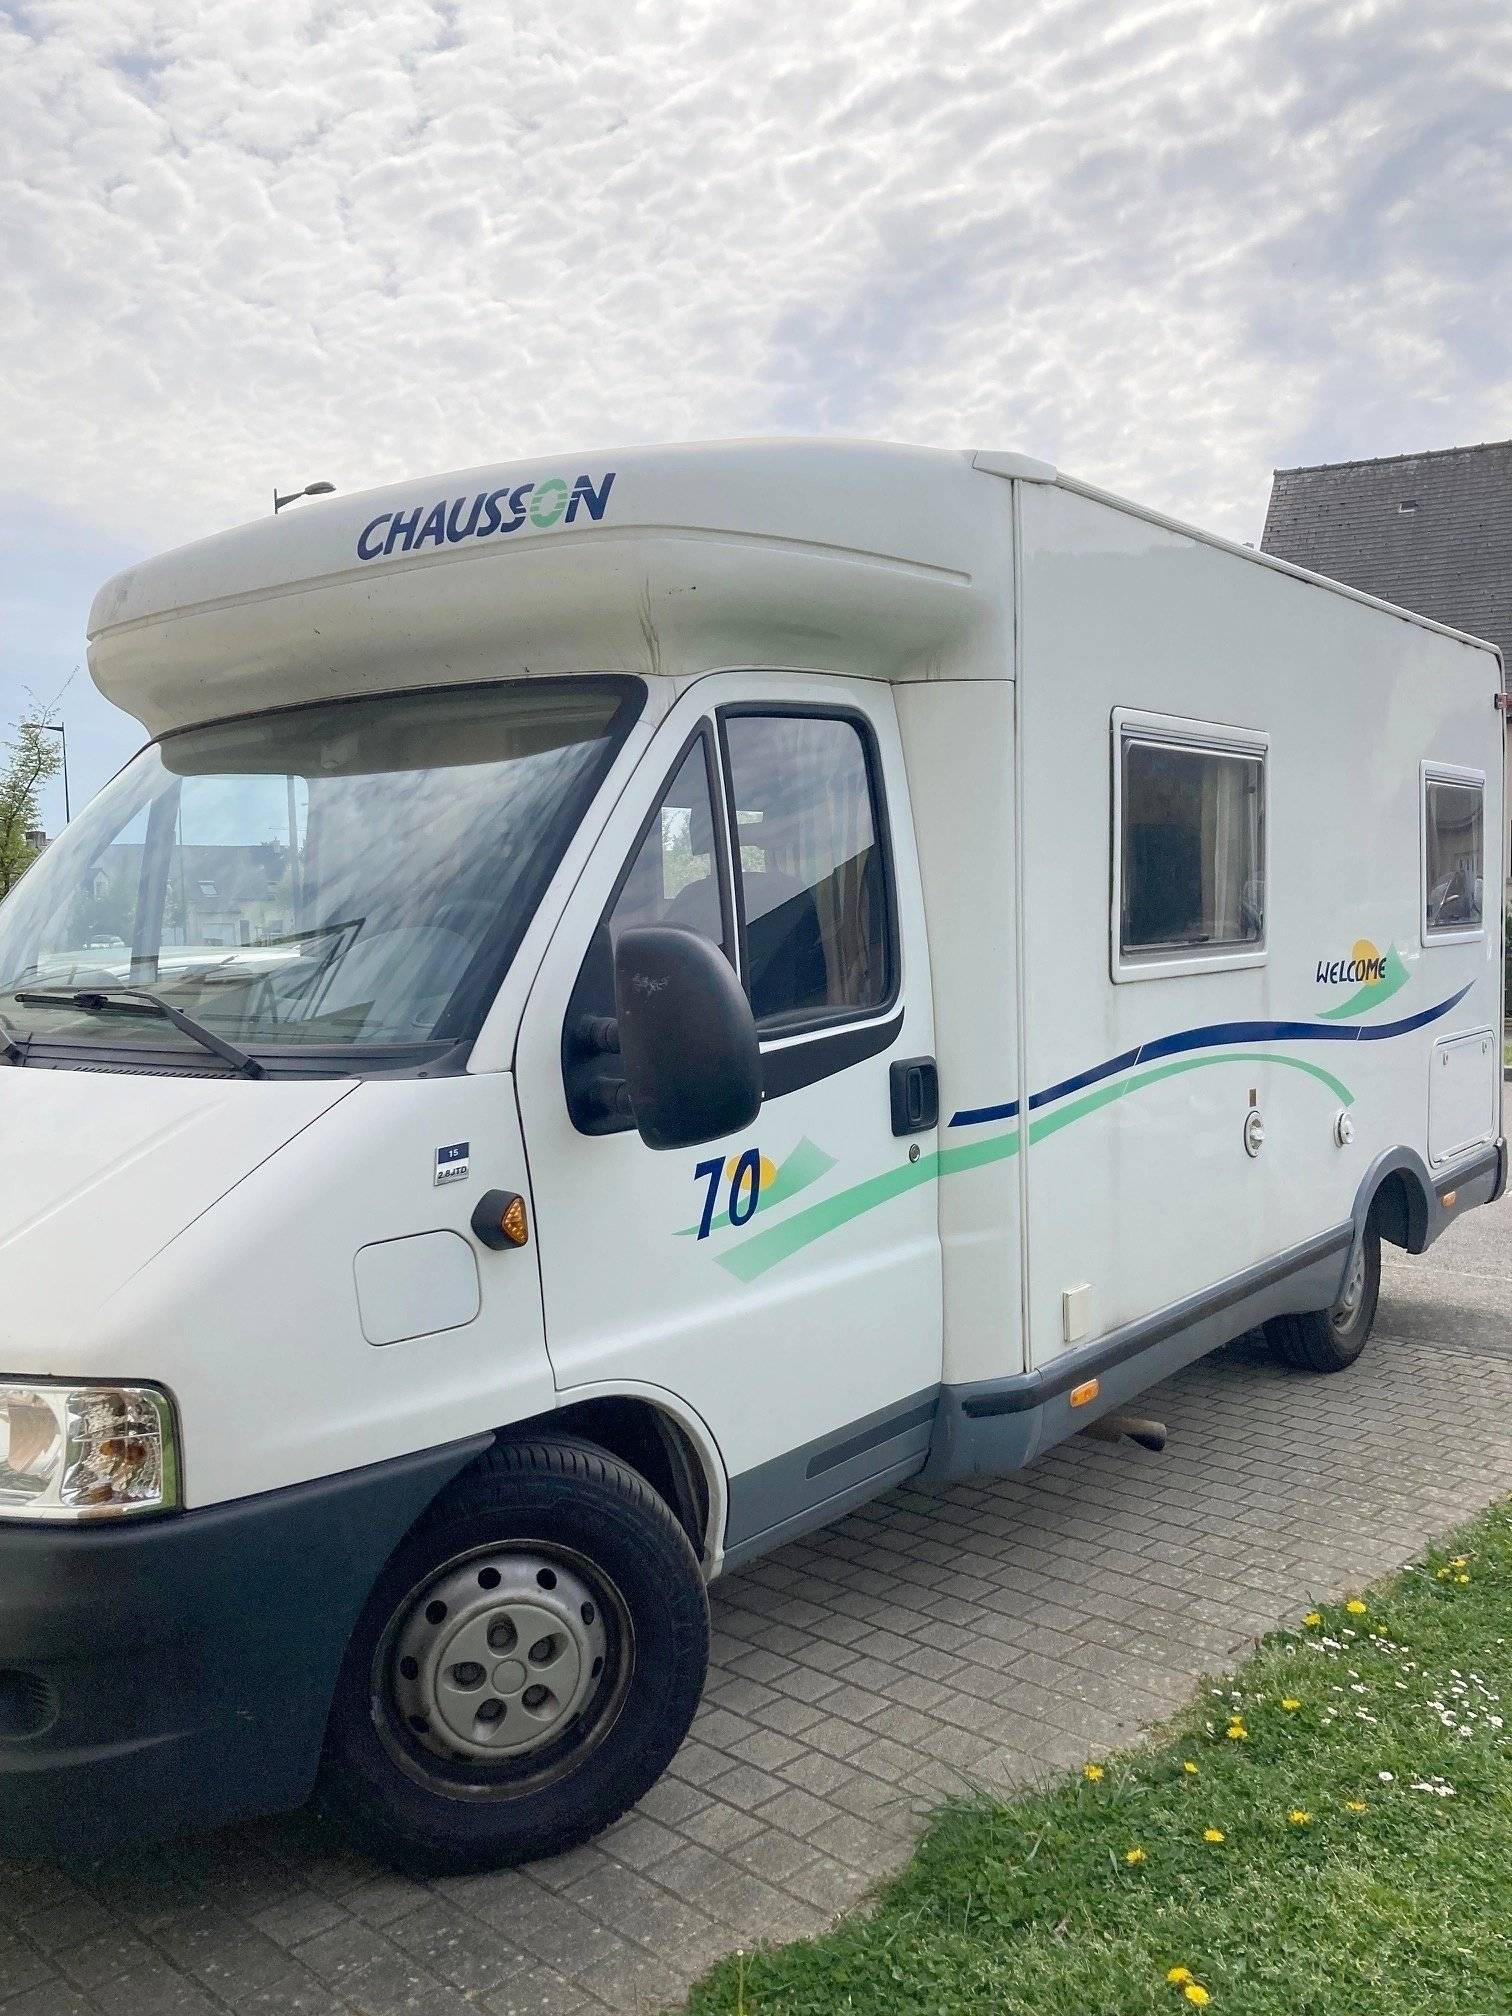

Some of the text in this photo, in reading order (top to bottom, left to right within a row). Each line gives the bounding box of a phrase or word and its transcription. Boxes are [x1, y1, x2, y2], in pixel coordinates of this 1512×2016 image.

[357, 472, 616, 560] CHAUSSON
[1316, 957, 1387, 984] WELCOME
[448, 1149, 459, 1158] 15
[693, 1148, 760, 1241] 70
